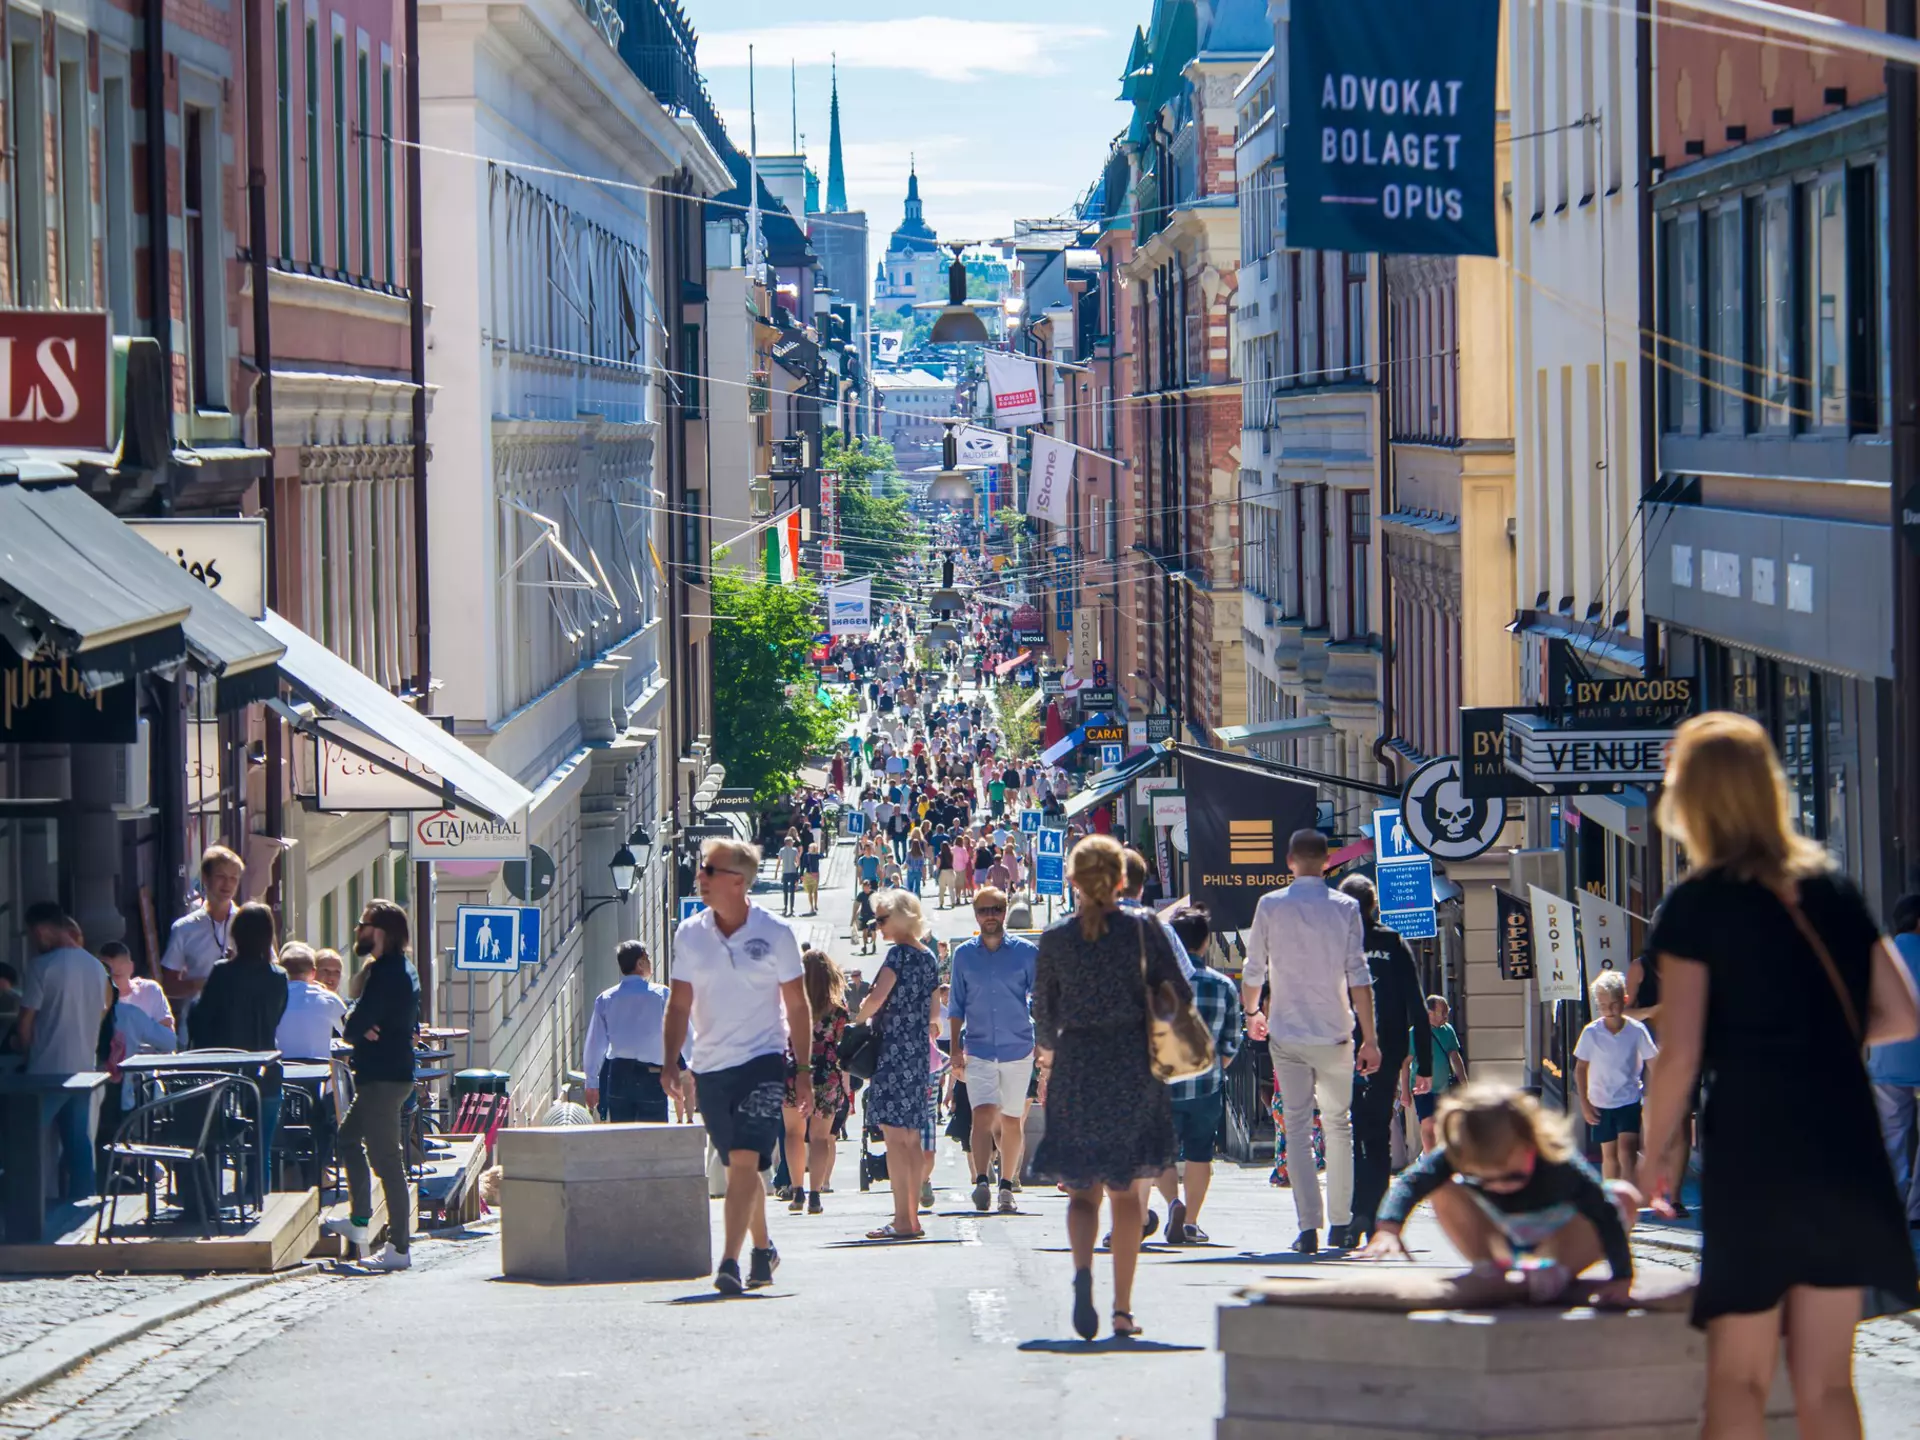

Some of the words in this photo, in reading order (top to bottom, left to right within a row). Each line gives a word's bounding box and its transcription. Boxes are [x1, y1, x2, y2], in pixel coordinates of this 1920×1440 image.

[1321, 73, 1463, 116] ADVOKAT
[1321, 126, 1462, 171] BOLAGET
[1383, 183, 1463, 221] OPUS
[998, 392, 1033, 402] KONSULT
[999, 397, 1034, 407] KOMPANIET
[1059, 560, 1071, 627] HOTEL
[831, 617, 868, 626] SKAGEN
[1021, 635, 1044, 643] NICOLE
[1577, 682, 1603, 703] BY
[1610, 680, 1690, 703] JACOBS
[1578, 707, 1611, 719] HAIR
[1619, 707, 1628, 717] &
[1636, 705, 1690, 718] BEAUTY
[1086, 728, 1124, 741] CARAT
[1473, 731, 1504, 756] BY
[1547, 741, 1668, 772] VENUE
[426, 820, 466, 847] TAJ
[466, 820, 521, 835] MAHAL
[492, 834, 521, 843] Beauty
[1203, 874, 1243, 886] PHIL'S
[1246, 874, 1295, 886] BURGE
[1547, 904, 1560, 953] DROP
[1507, 912, 1530, 977] ÖPPET
[1598, 915, 1613, 970] SHO
